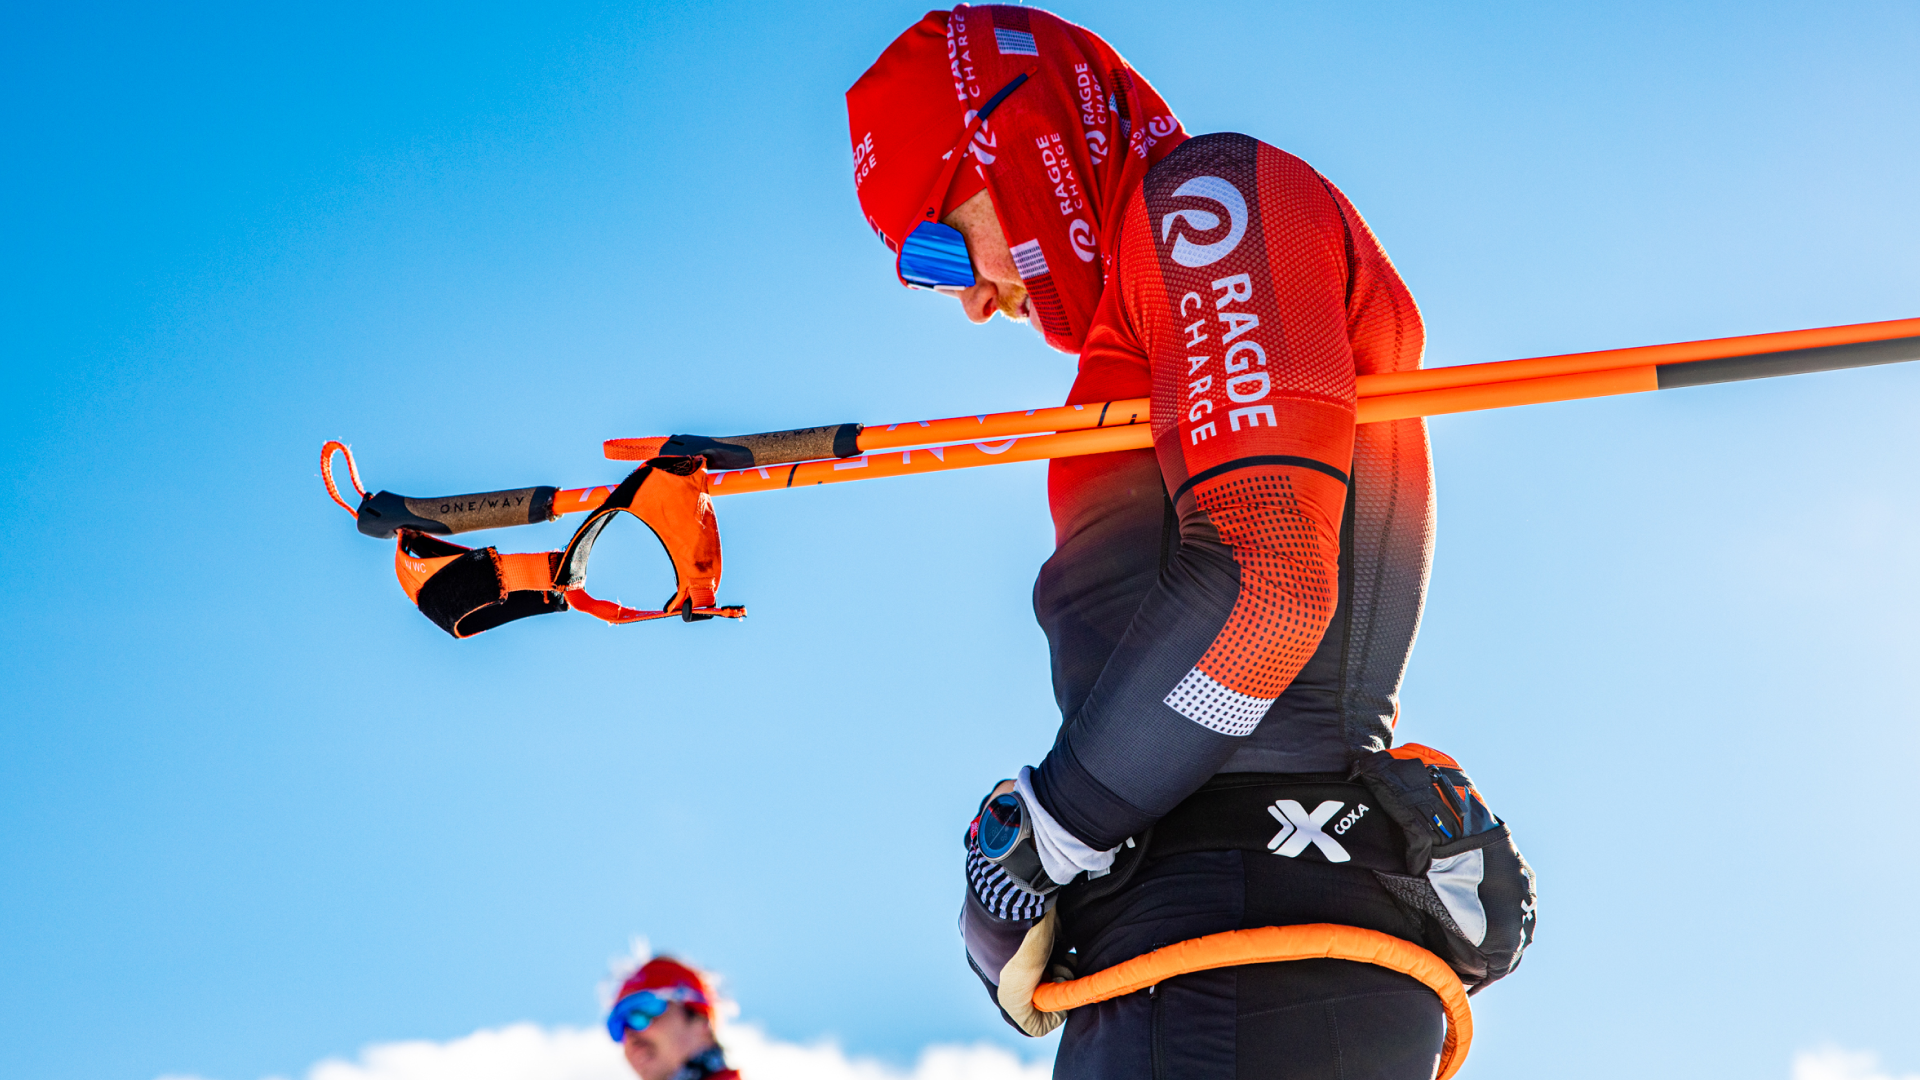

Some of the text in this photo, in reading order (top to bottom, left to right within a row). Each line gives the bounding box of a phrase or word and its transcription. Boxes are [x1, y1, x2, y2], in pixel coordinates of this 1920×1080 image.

[955, 14, 981, 97] CHARGE
[1075, 62, 1095, 125] RAGDE
[1035, 134, 1074, 216] RAGDE
[1050, 132, 1083, 210] CHARGE
[1180, 291, 1217, 446] CHARGE
[1211, 272, 1278, 433] RAGDE
[440, 497, 525, 514] ONE/WAY
[1334, 803, 1370, 835] COXA
